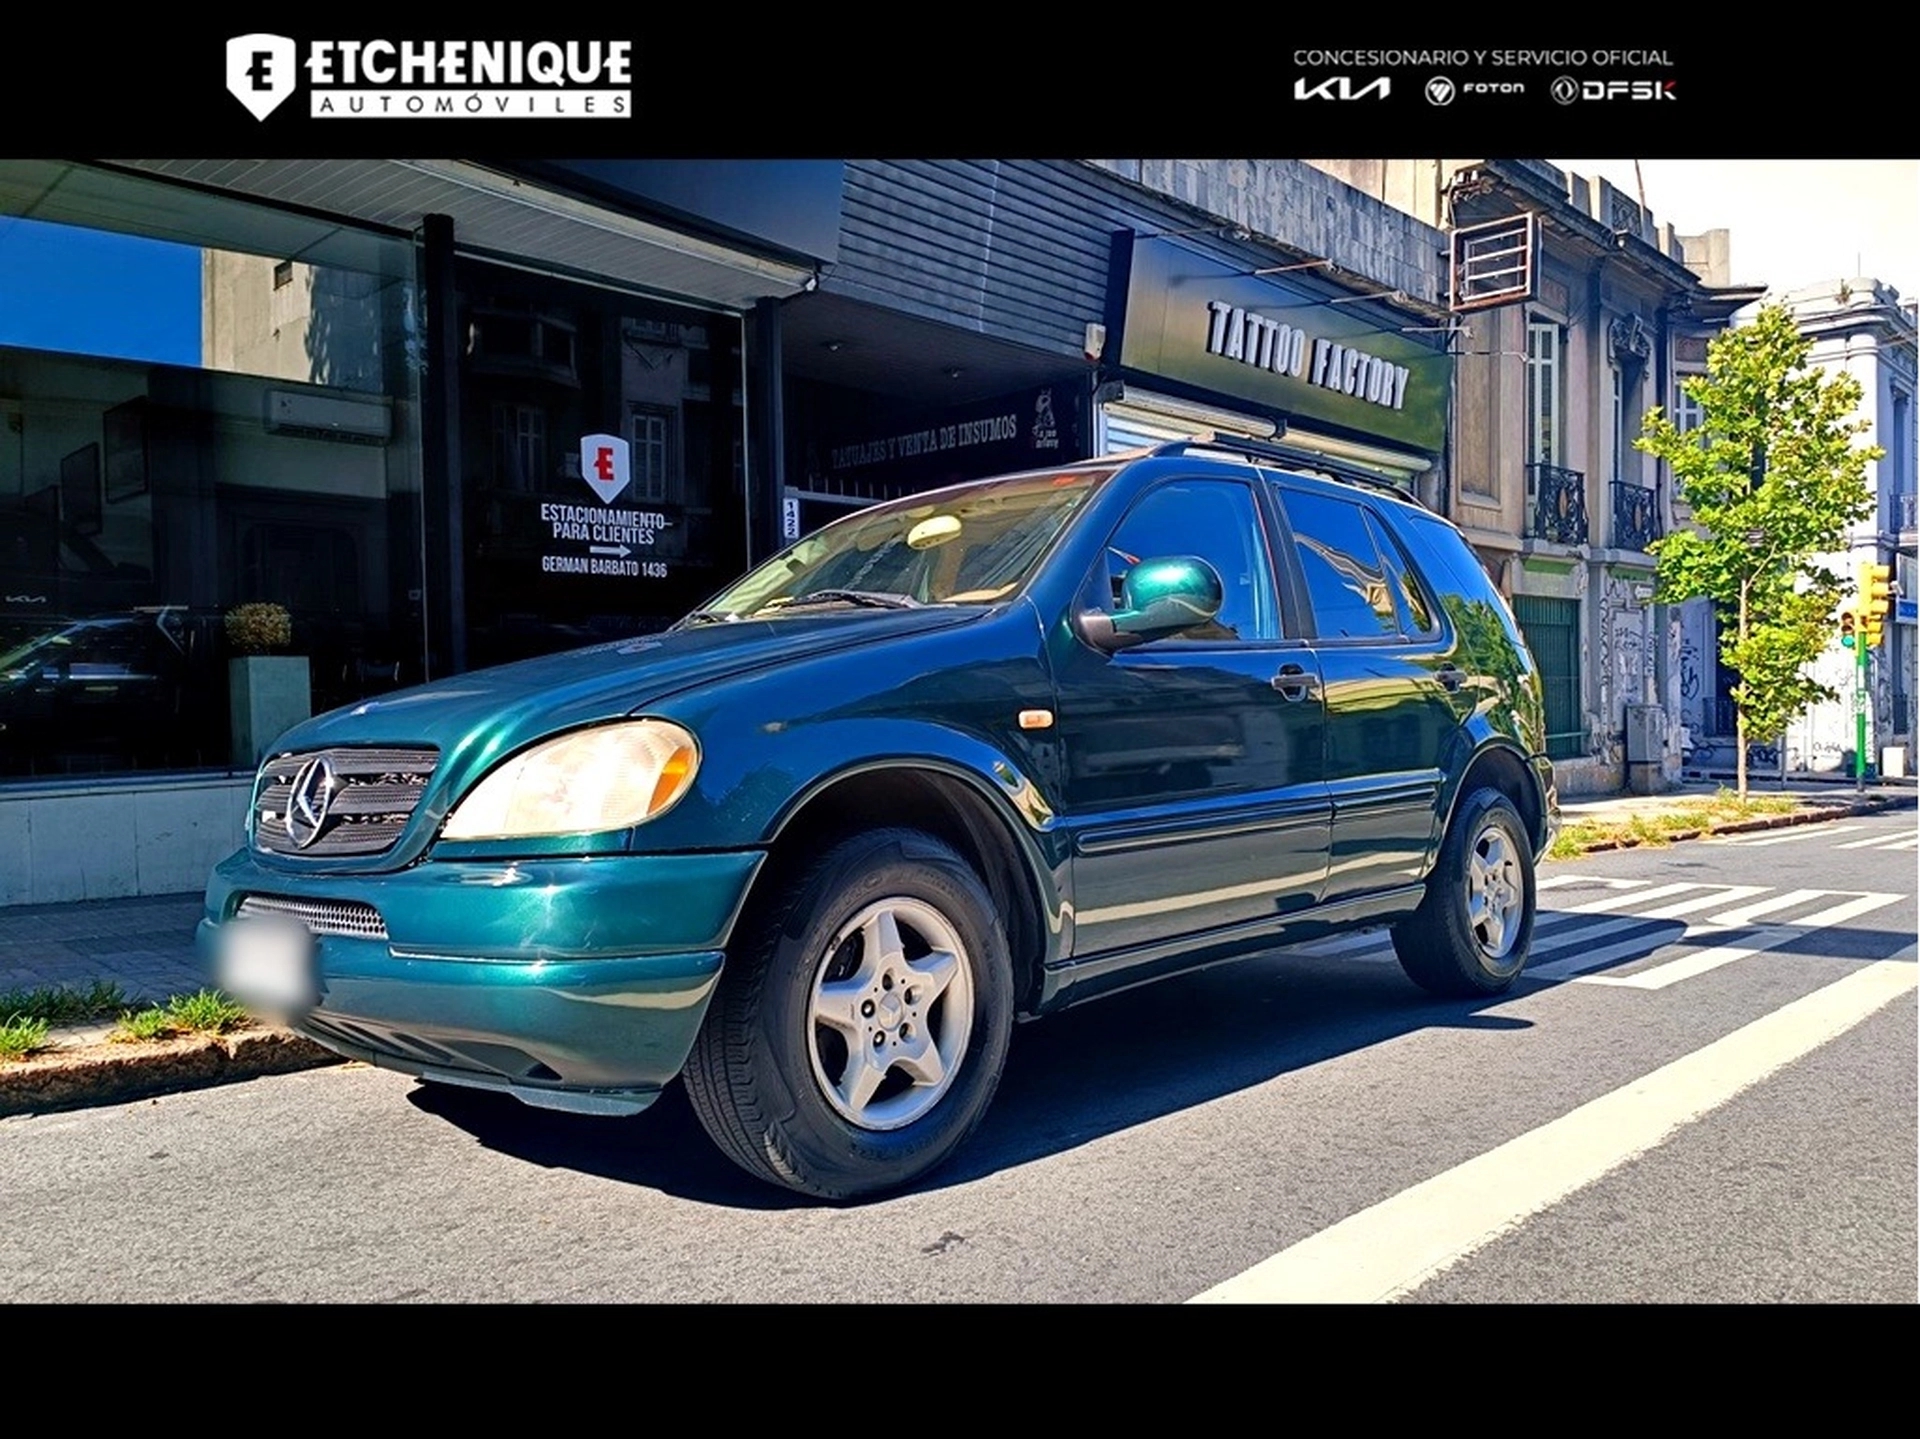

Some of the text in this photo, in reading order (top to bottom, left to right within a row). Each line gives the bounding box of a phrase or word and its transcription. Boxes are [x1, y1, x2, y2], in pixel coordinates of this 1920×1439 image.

[1209, 301, 1409, 410] TATTOO FACTORY
[831, 437, 887, 469] TATUAJES
[887, 438, 896, 459] Y
[897, 429, 938, 457] VENTA
[940, 425, 957, 449] DE
[958, 414, 1017, 446] INSUMOS
[541, 503, 665, 530] ESTACIONAMIENTO
[553, 522, 654, 545] PARA CLIENTES
[542, 556, 668, 578] GERMAN BARBATO 1436
